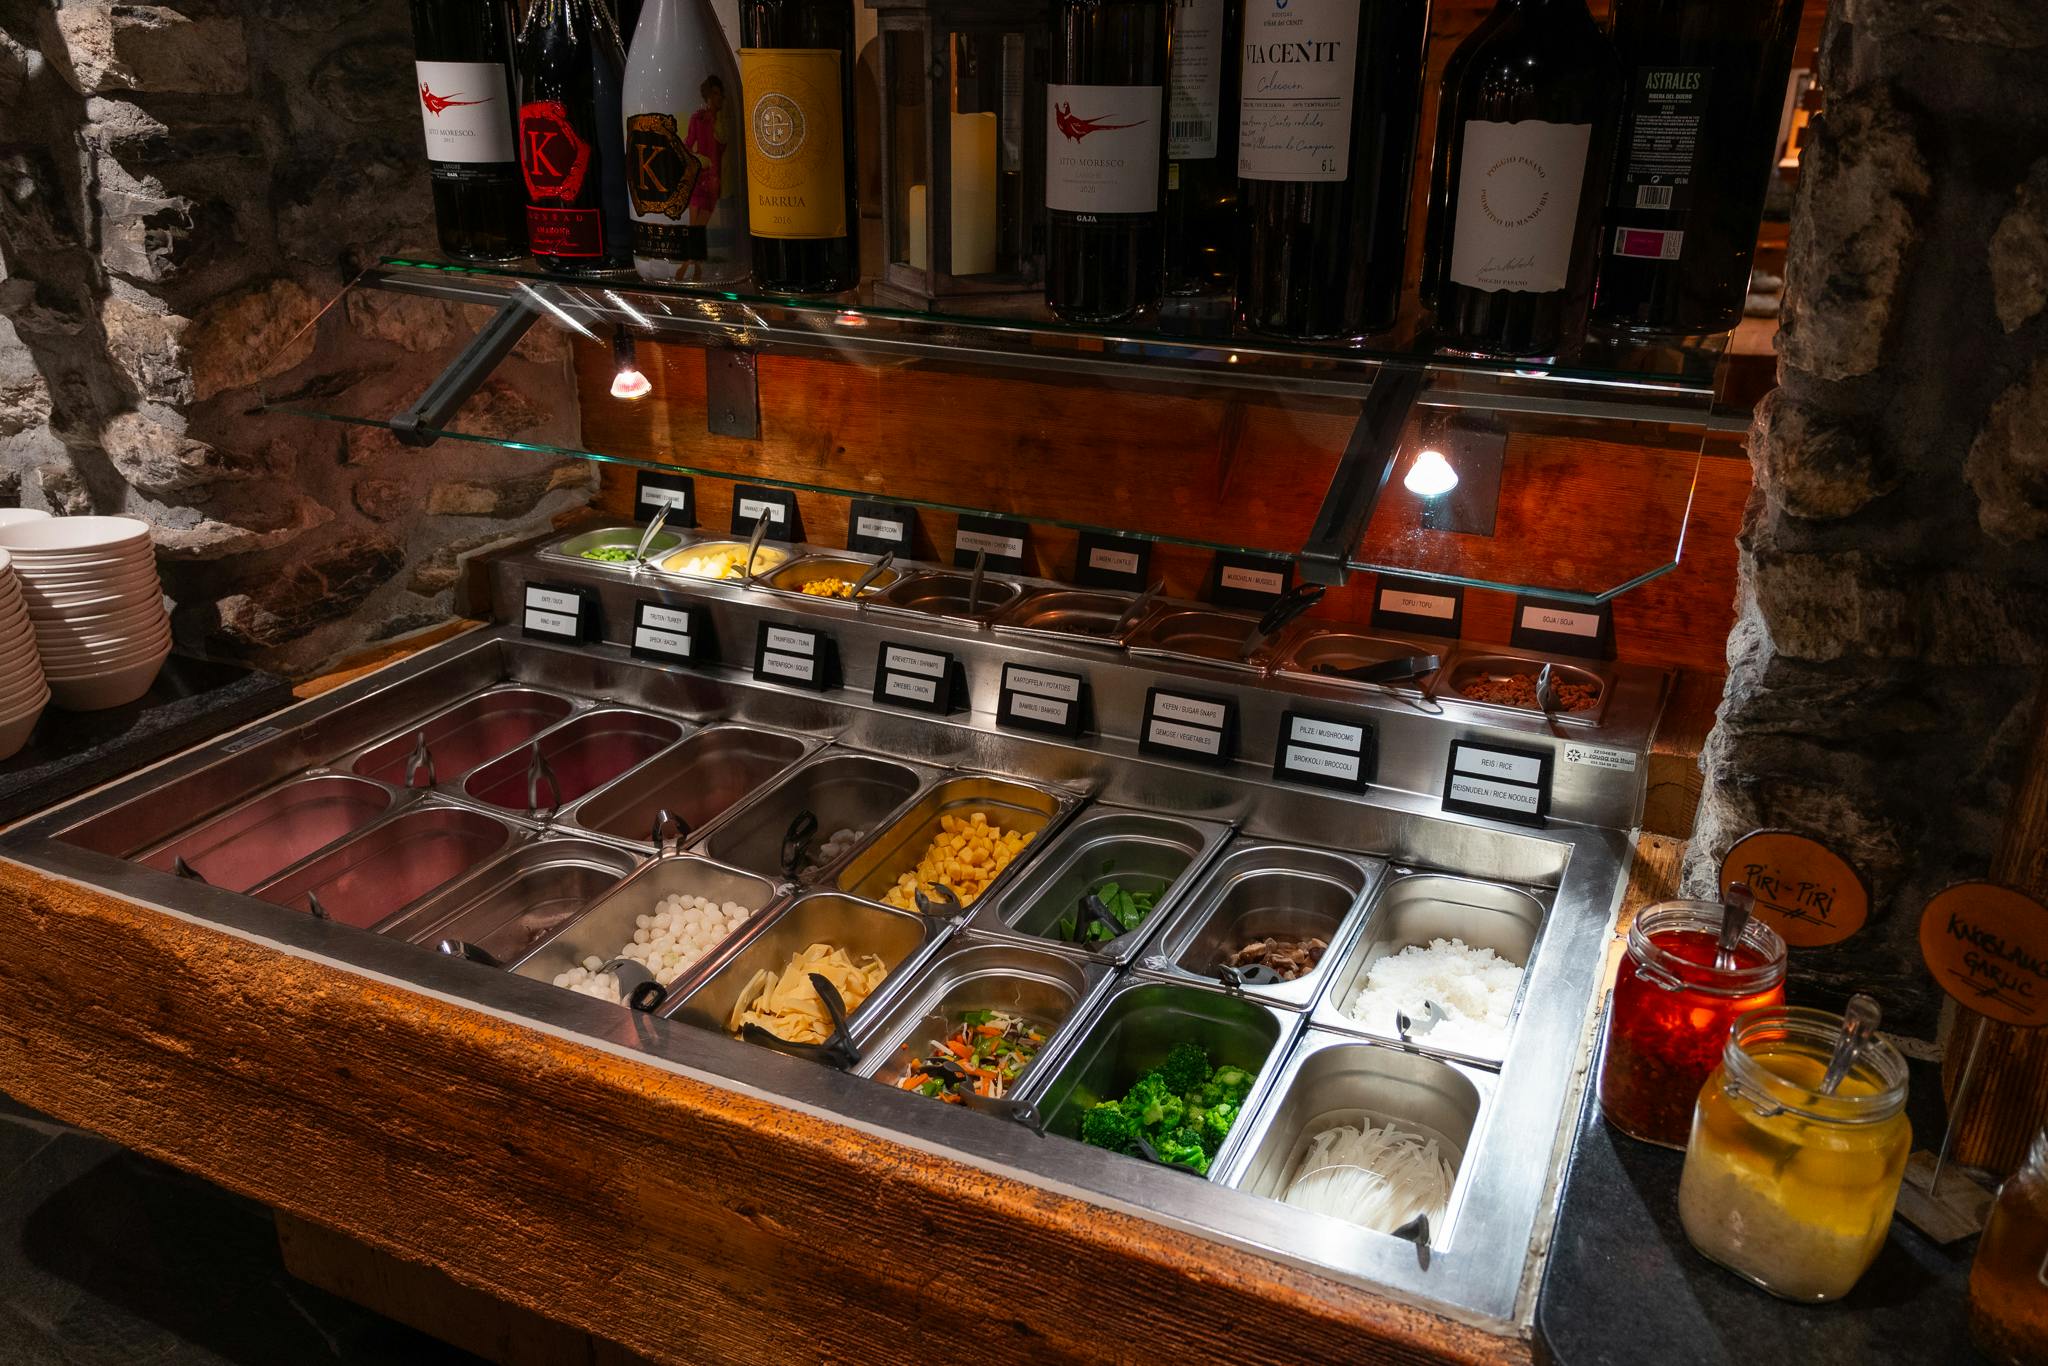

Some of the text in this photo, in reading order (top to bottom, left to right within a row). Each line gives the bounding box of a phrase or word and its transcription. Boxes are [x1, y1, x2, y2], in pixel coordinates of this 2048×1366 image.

[1269, 41, 1341, 63] CENIT
[1645, 72, 1701, 91] ASTRALES
[528, 131, 562, 176] K
[635, 143, 669, 192] K
[759, 195, 807, 208] BARRUA
[1076, 214, 1098, 223] GAJA
[1402, 599, 1416, 607] TOFU
[1418, 601, 1432, 609] TOFU
[1162, 702, 1179, 711] KEFEN
[1181, 705, 1199, 716] SUGAR
[1200, 709, 1217, 719] SNAPS
[1179, 732, 1211, 745] VEGETABLES
[1299, 726, 1315, 735] PILZE
[1318, 729, 1354, 742] MUSHROOMS
[1293, 754, 1321, 765] BROKKOLI
[1324, 760, 1352, 772] BROCCOLI
[1481, 758, 1495, 768] REIS
[1499, 762, 1513, 771] RICE
[1452, 783, 1490, 796] REISNUDELN
[1492, 789, 1507, 799] RICE
[1506, 792, 1537, 805] NOODLES
[1963, 951, 2036, 998] GARLIC
